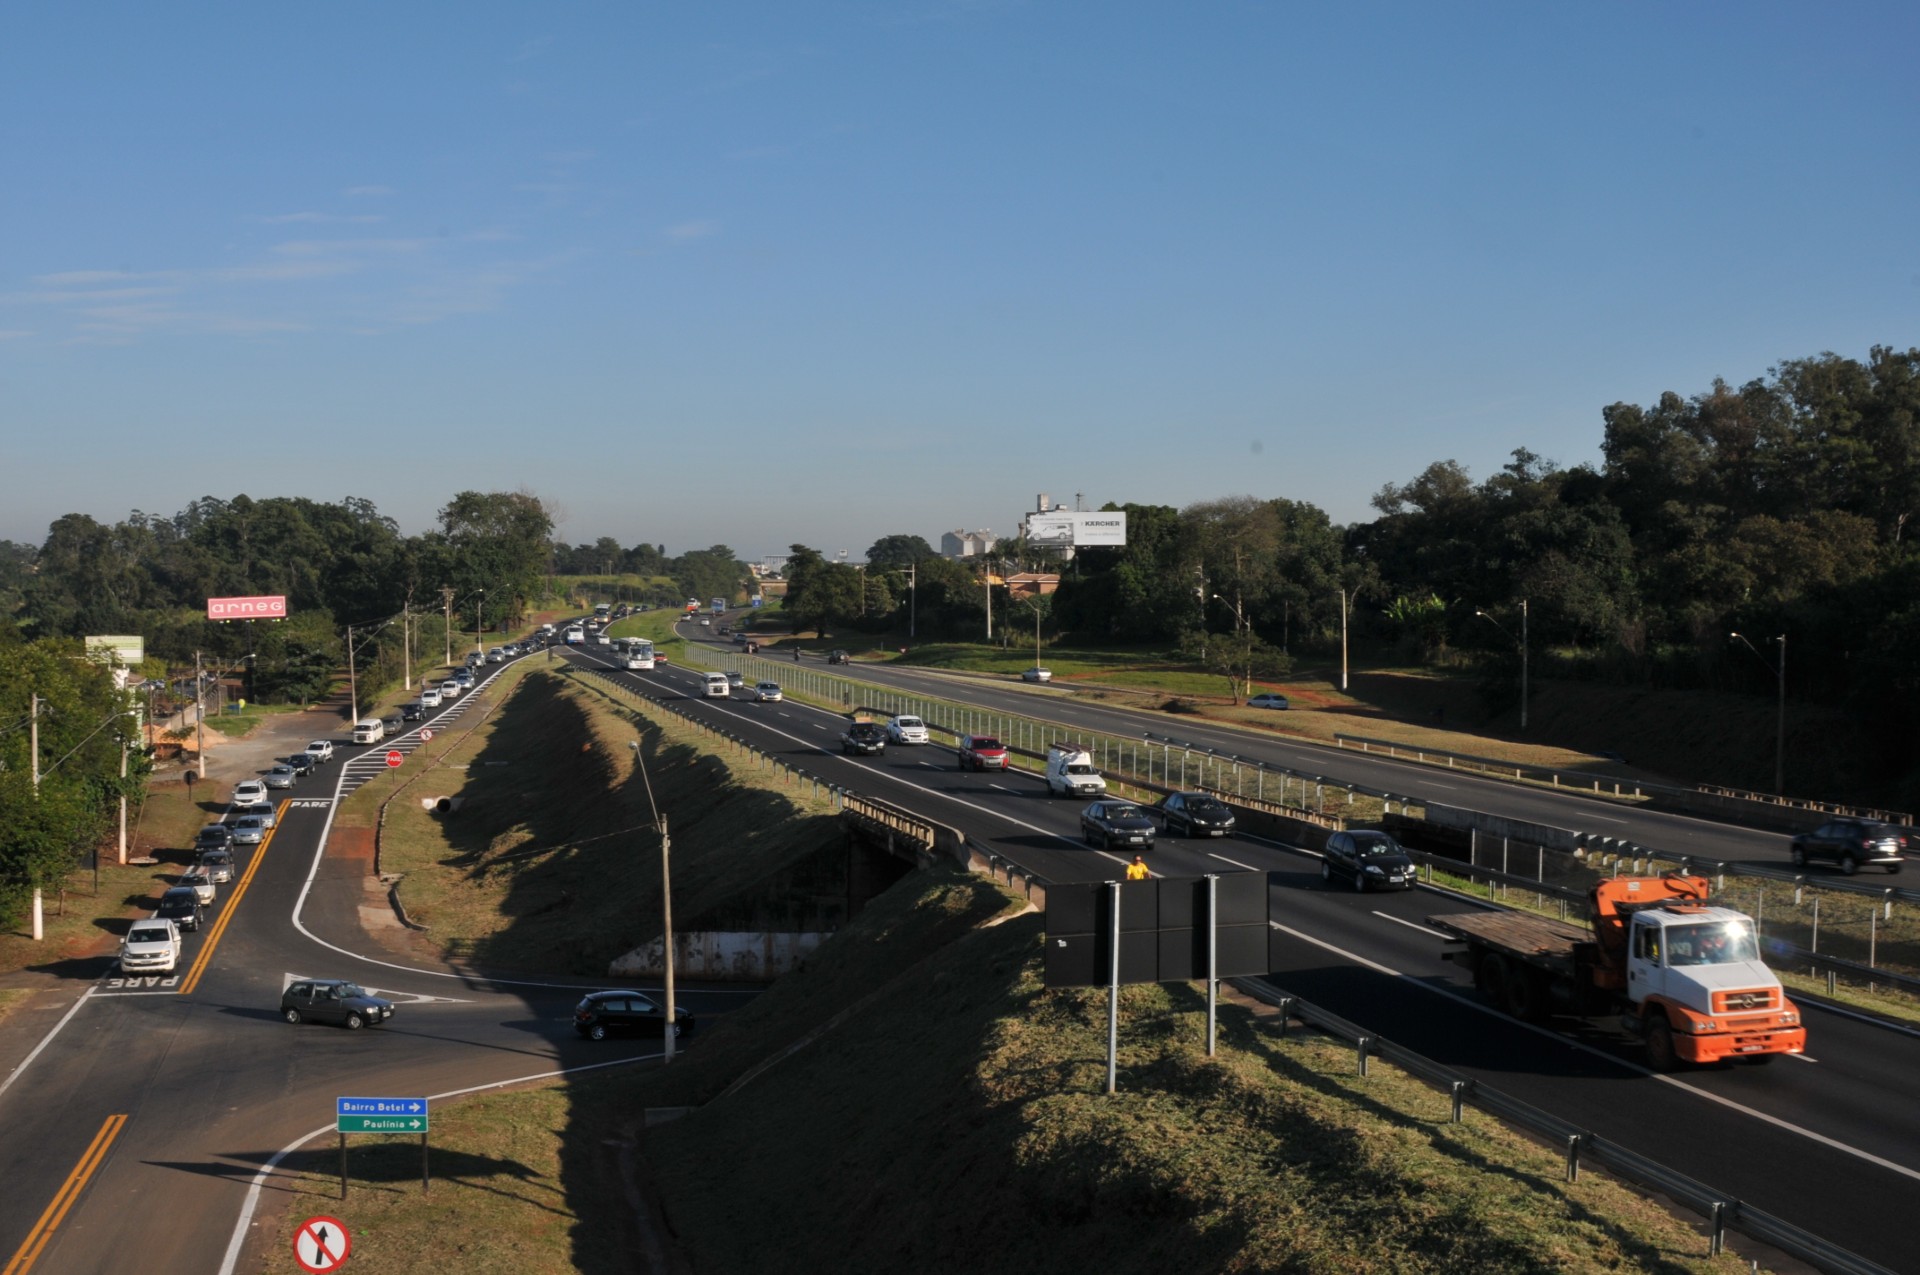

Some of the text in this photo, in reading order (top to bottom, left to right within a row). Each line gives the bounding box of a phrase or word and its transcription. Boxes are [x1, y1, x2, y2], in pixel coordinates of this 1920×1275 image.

[106, 976, 180, 988] PARE
[343, 1102, 405, 1111] Bairro Betel
[363, 1120, 405, 1128] Paulínia
